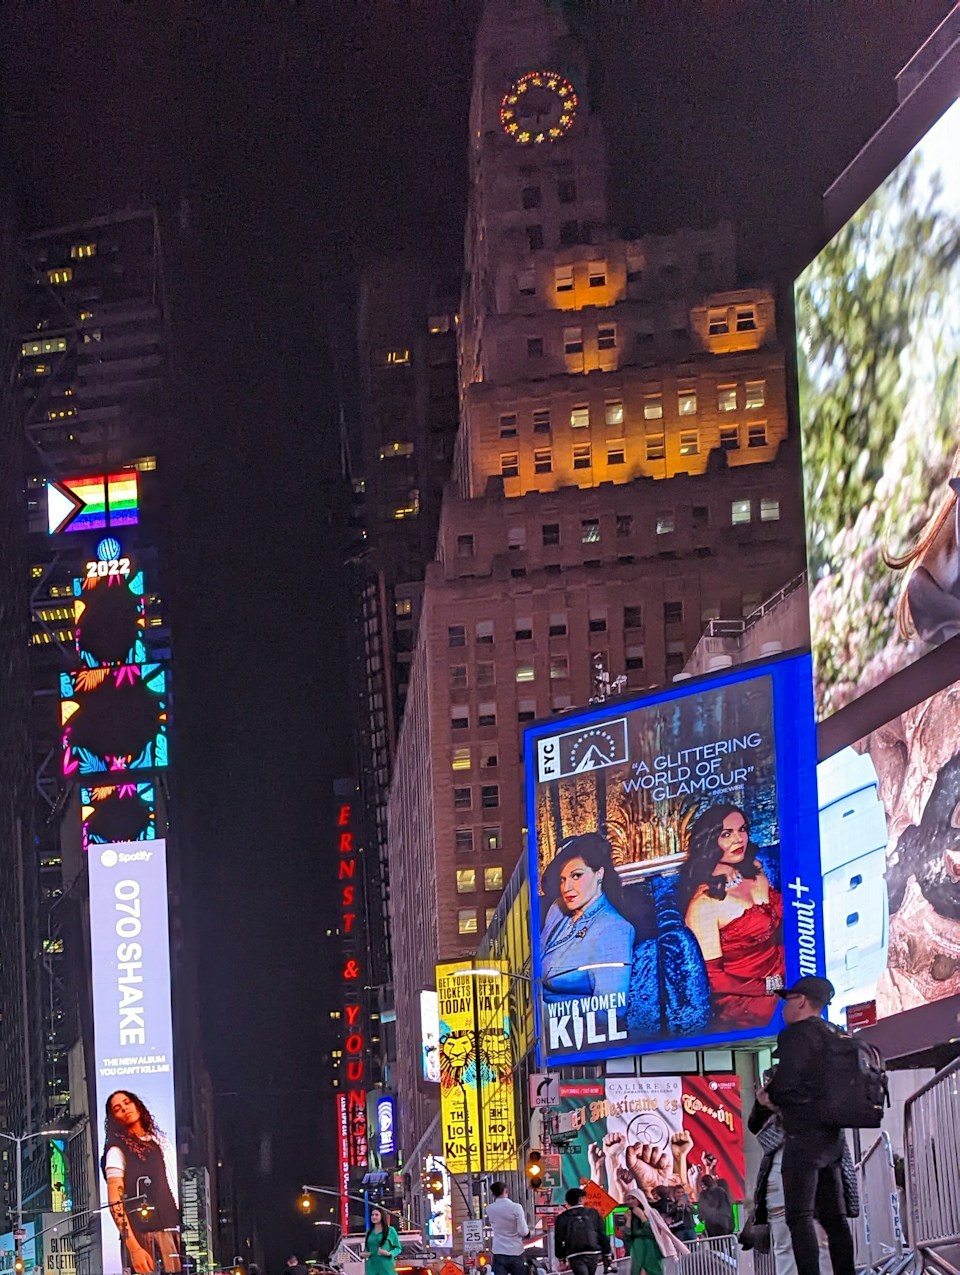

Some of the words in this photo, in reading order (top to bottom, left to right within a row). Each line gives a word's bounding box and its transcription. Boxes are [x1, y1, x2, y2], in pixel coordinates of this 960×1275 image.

[87, 558, 130, 578] 2022
[542, 743, 556, 774] FYC
[654, 732, 762, 769] GLITTERING
[623, 767, 690, 793] WORLD
[696, 758, 722, 776] OF
[118, 850, 152, 863] Spotify
[339, 805, 356, 933] ERNST
[114, 879, 142, 939] 070
[343, 959, 360, 979] &
[438, 978, 450, 987] GET
[439, 986, 470, 999] TICKETS
[117, 943, 145, 1047] SHAKE
[548, 1003, 572, 1017] WHY
[577, 993, 626, 1012] WOMEN
[439, 998, 471, 1015] TODAY
[548, 1006, 628, 1051] KILL
[103, 1058, 118, 1067] THE
[118, 1057, 137, 1066] NEW
[137, 1055, 165, 1065] ALBUM
[609, 1083, 659, 1091] CALIBRE
[536, 1096, 556, 1104] ONLY
[567, 1146, 575, 1154] 45
[466, 1232, 481, 1242] 25
